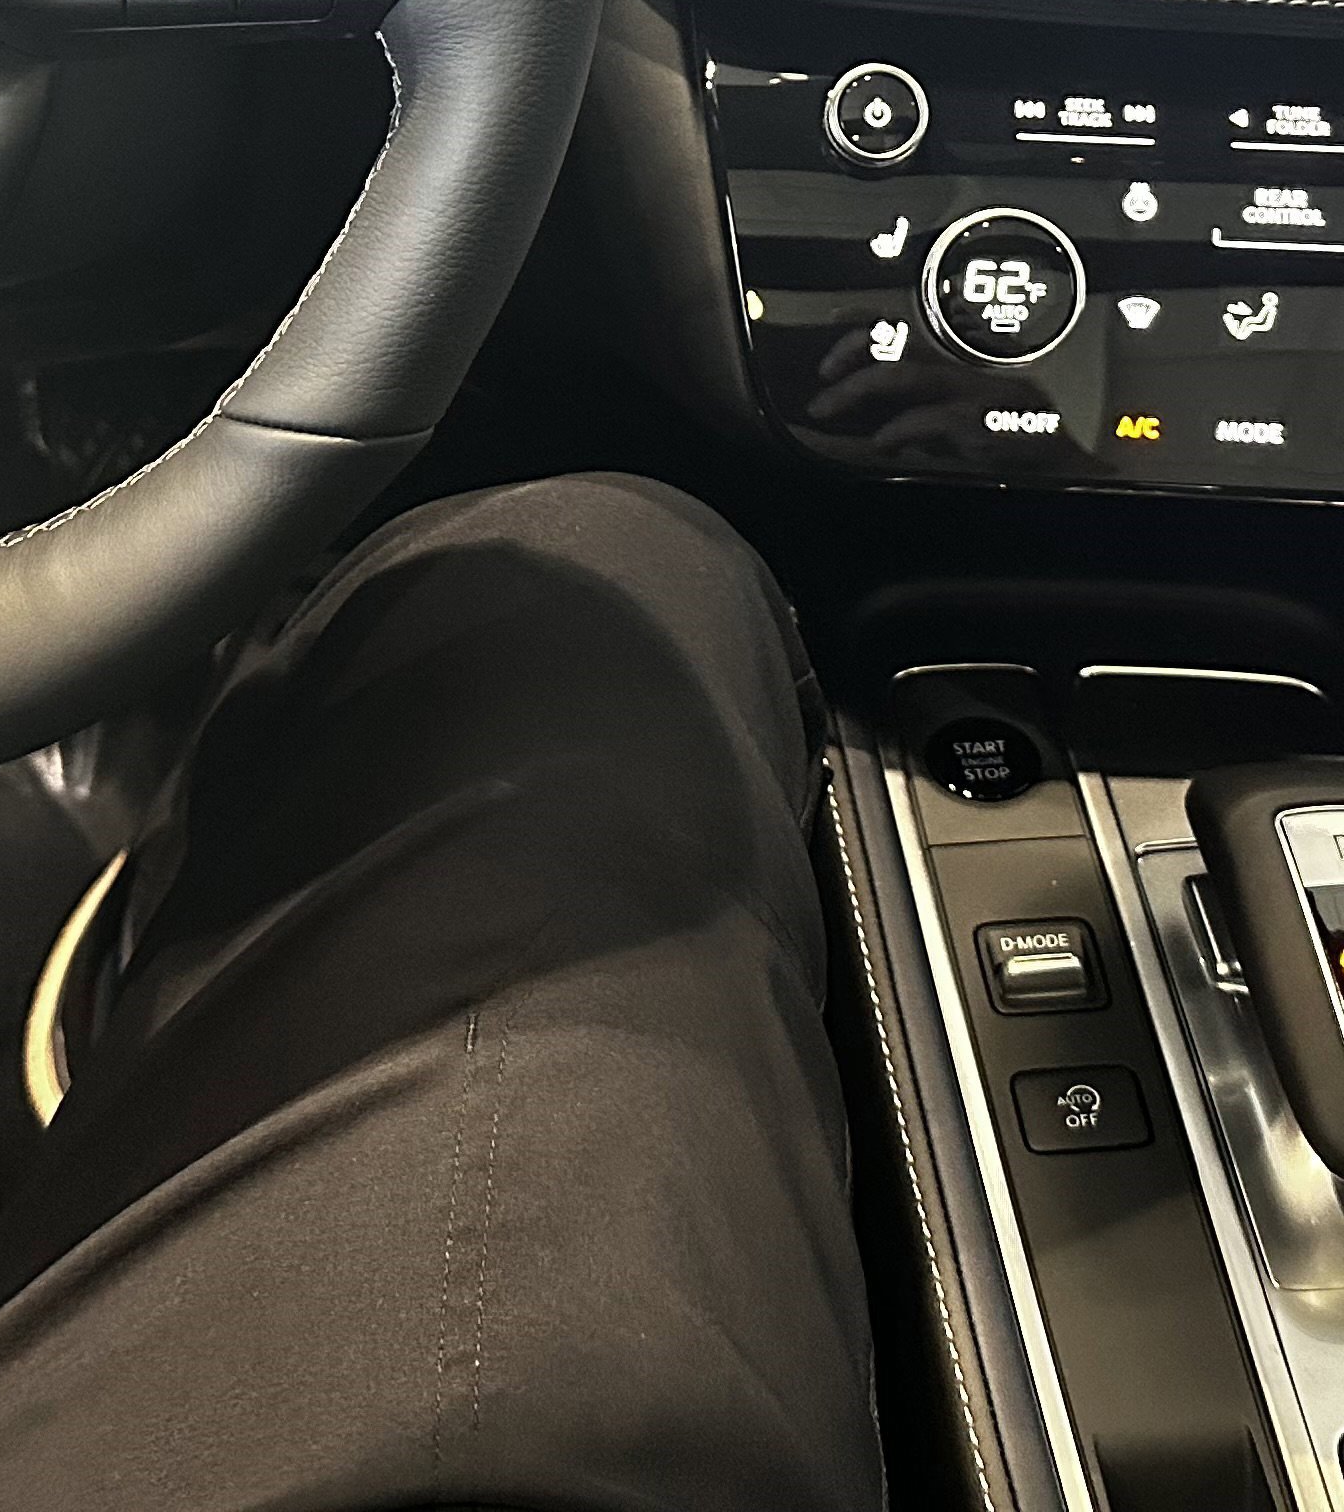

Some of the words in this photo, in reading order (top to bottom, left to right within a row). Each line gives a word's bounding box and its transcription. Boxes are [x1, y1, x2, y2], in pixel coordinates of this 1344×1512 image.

[1116, 415, 1160, 439] A/C
[1215, 420, 1285, 444] MODE
[952, 739, 1006, 755] START
[964, 766, 1010, 780] STOP
[1057, 1092, 1094, 1107] AUTO
[1065, 1113, 1099, 1129] OFF
